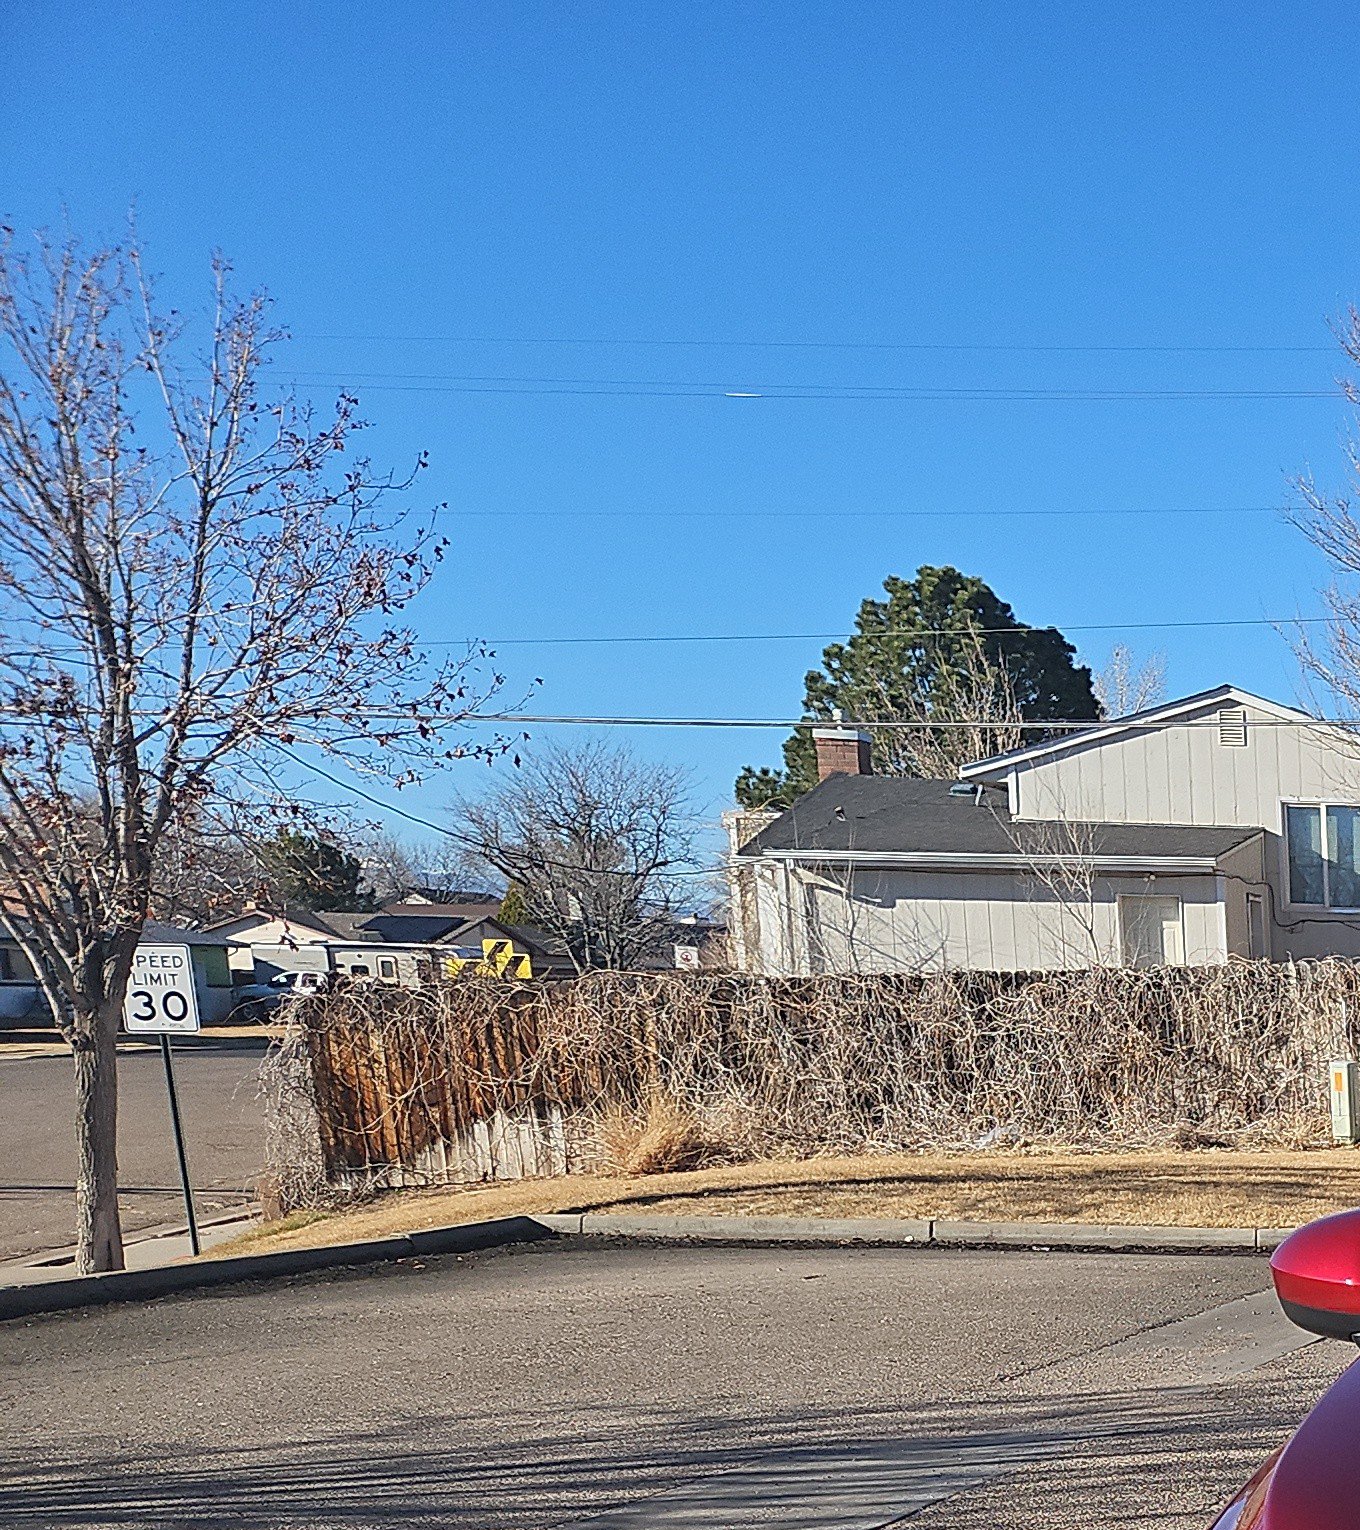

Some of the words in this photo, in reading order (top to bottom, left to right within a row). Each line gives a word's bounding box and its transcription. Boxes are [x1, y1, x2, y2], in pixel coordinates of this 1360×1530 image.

[135, 955, 184, 968] PEED
[132, 973, 178, 986] LIMIT
[131, 990, 189, 1021] 30
